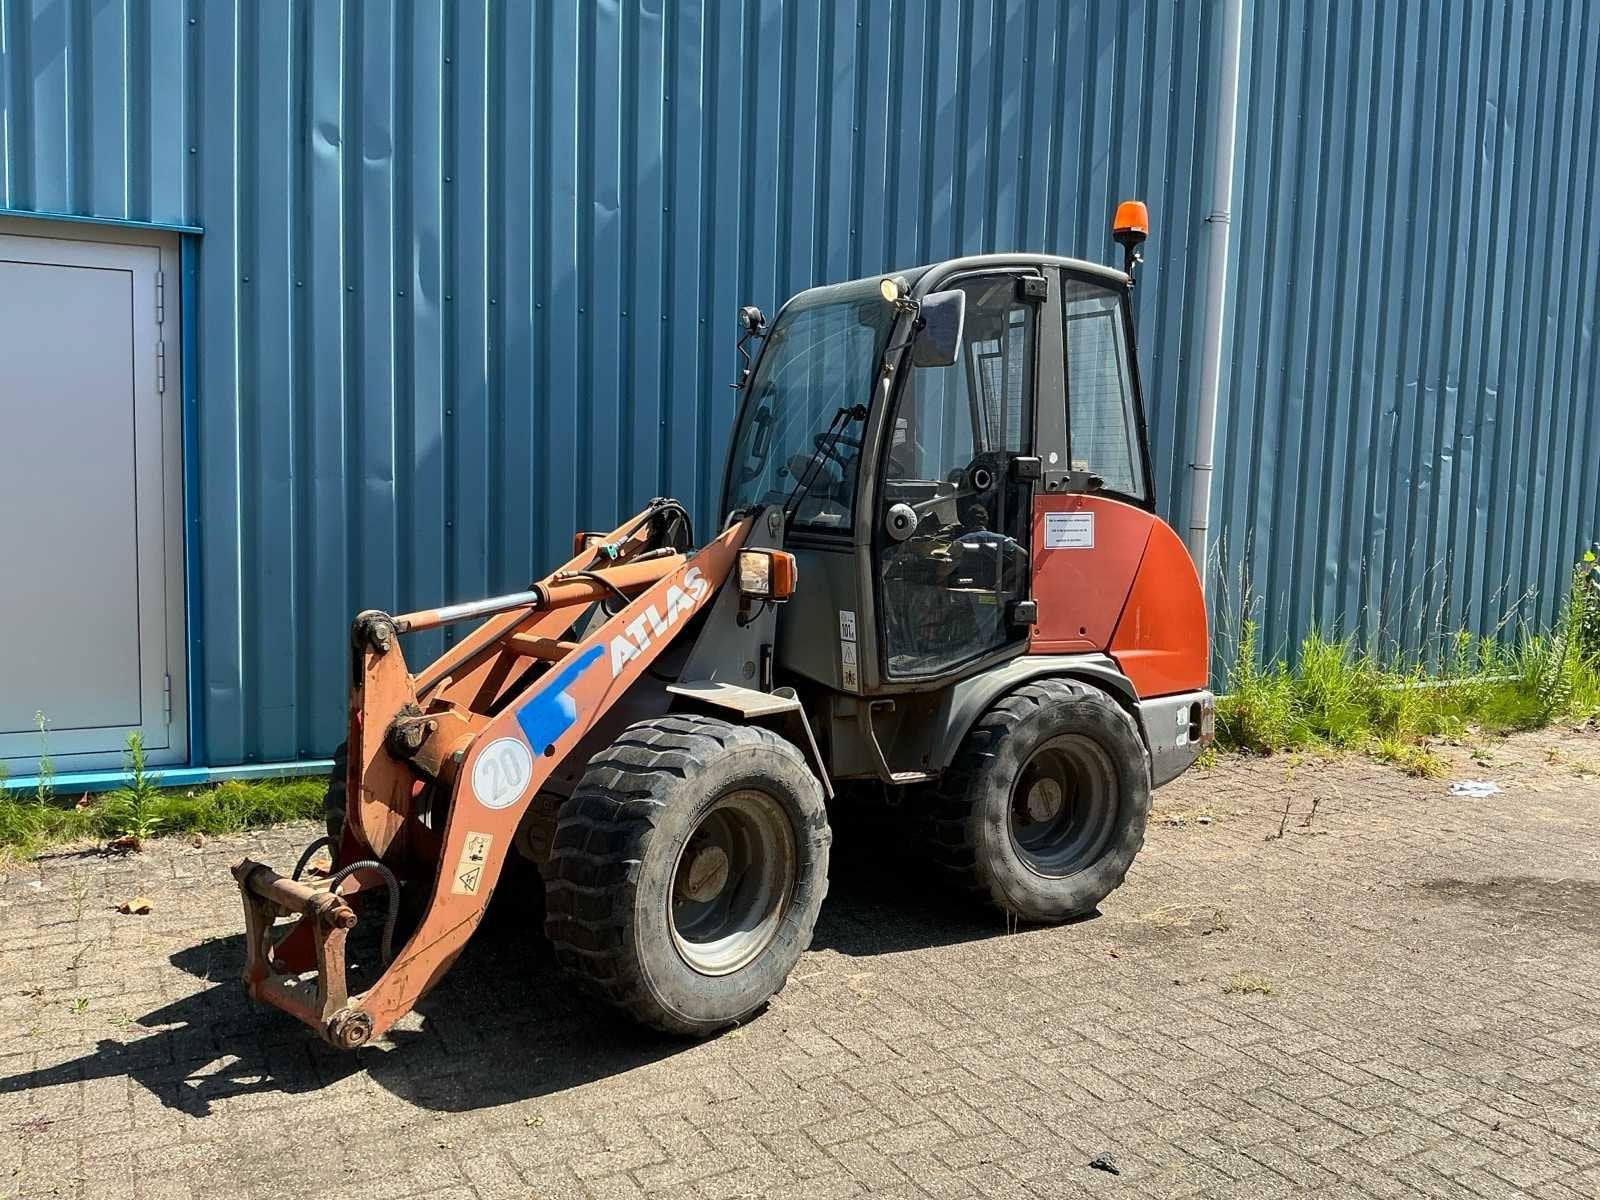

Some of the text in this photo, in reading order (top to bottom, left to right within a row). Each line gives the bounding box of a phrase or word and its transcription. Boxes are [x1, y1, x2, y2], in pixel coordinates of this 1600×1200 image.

[610, 566, 708, 678] ATLAS
[842, 623, 851, 638] 101
[482, 747, 522, 801] 20
